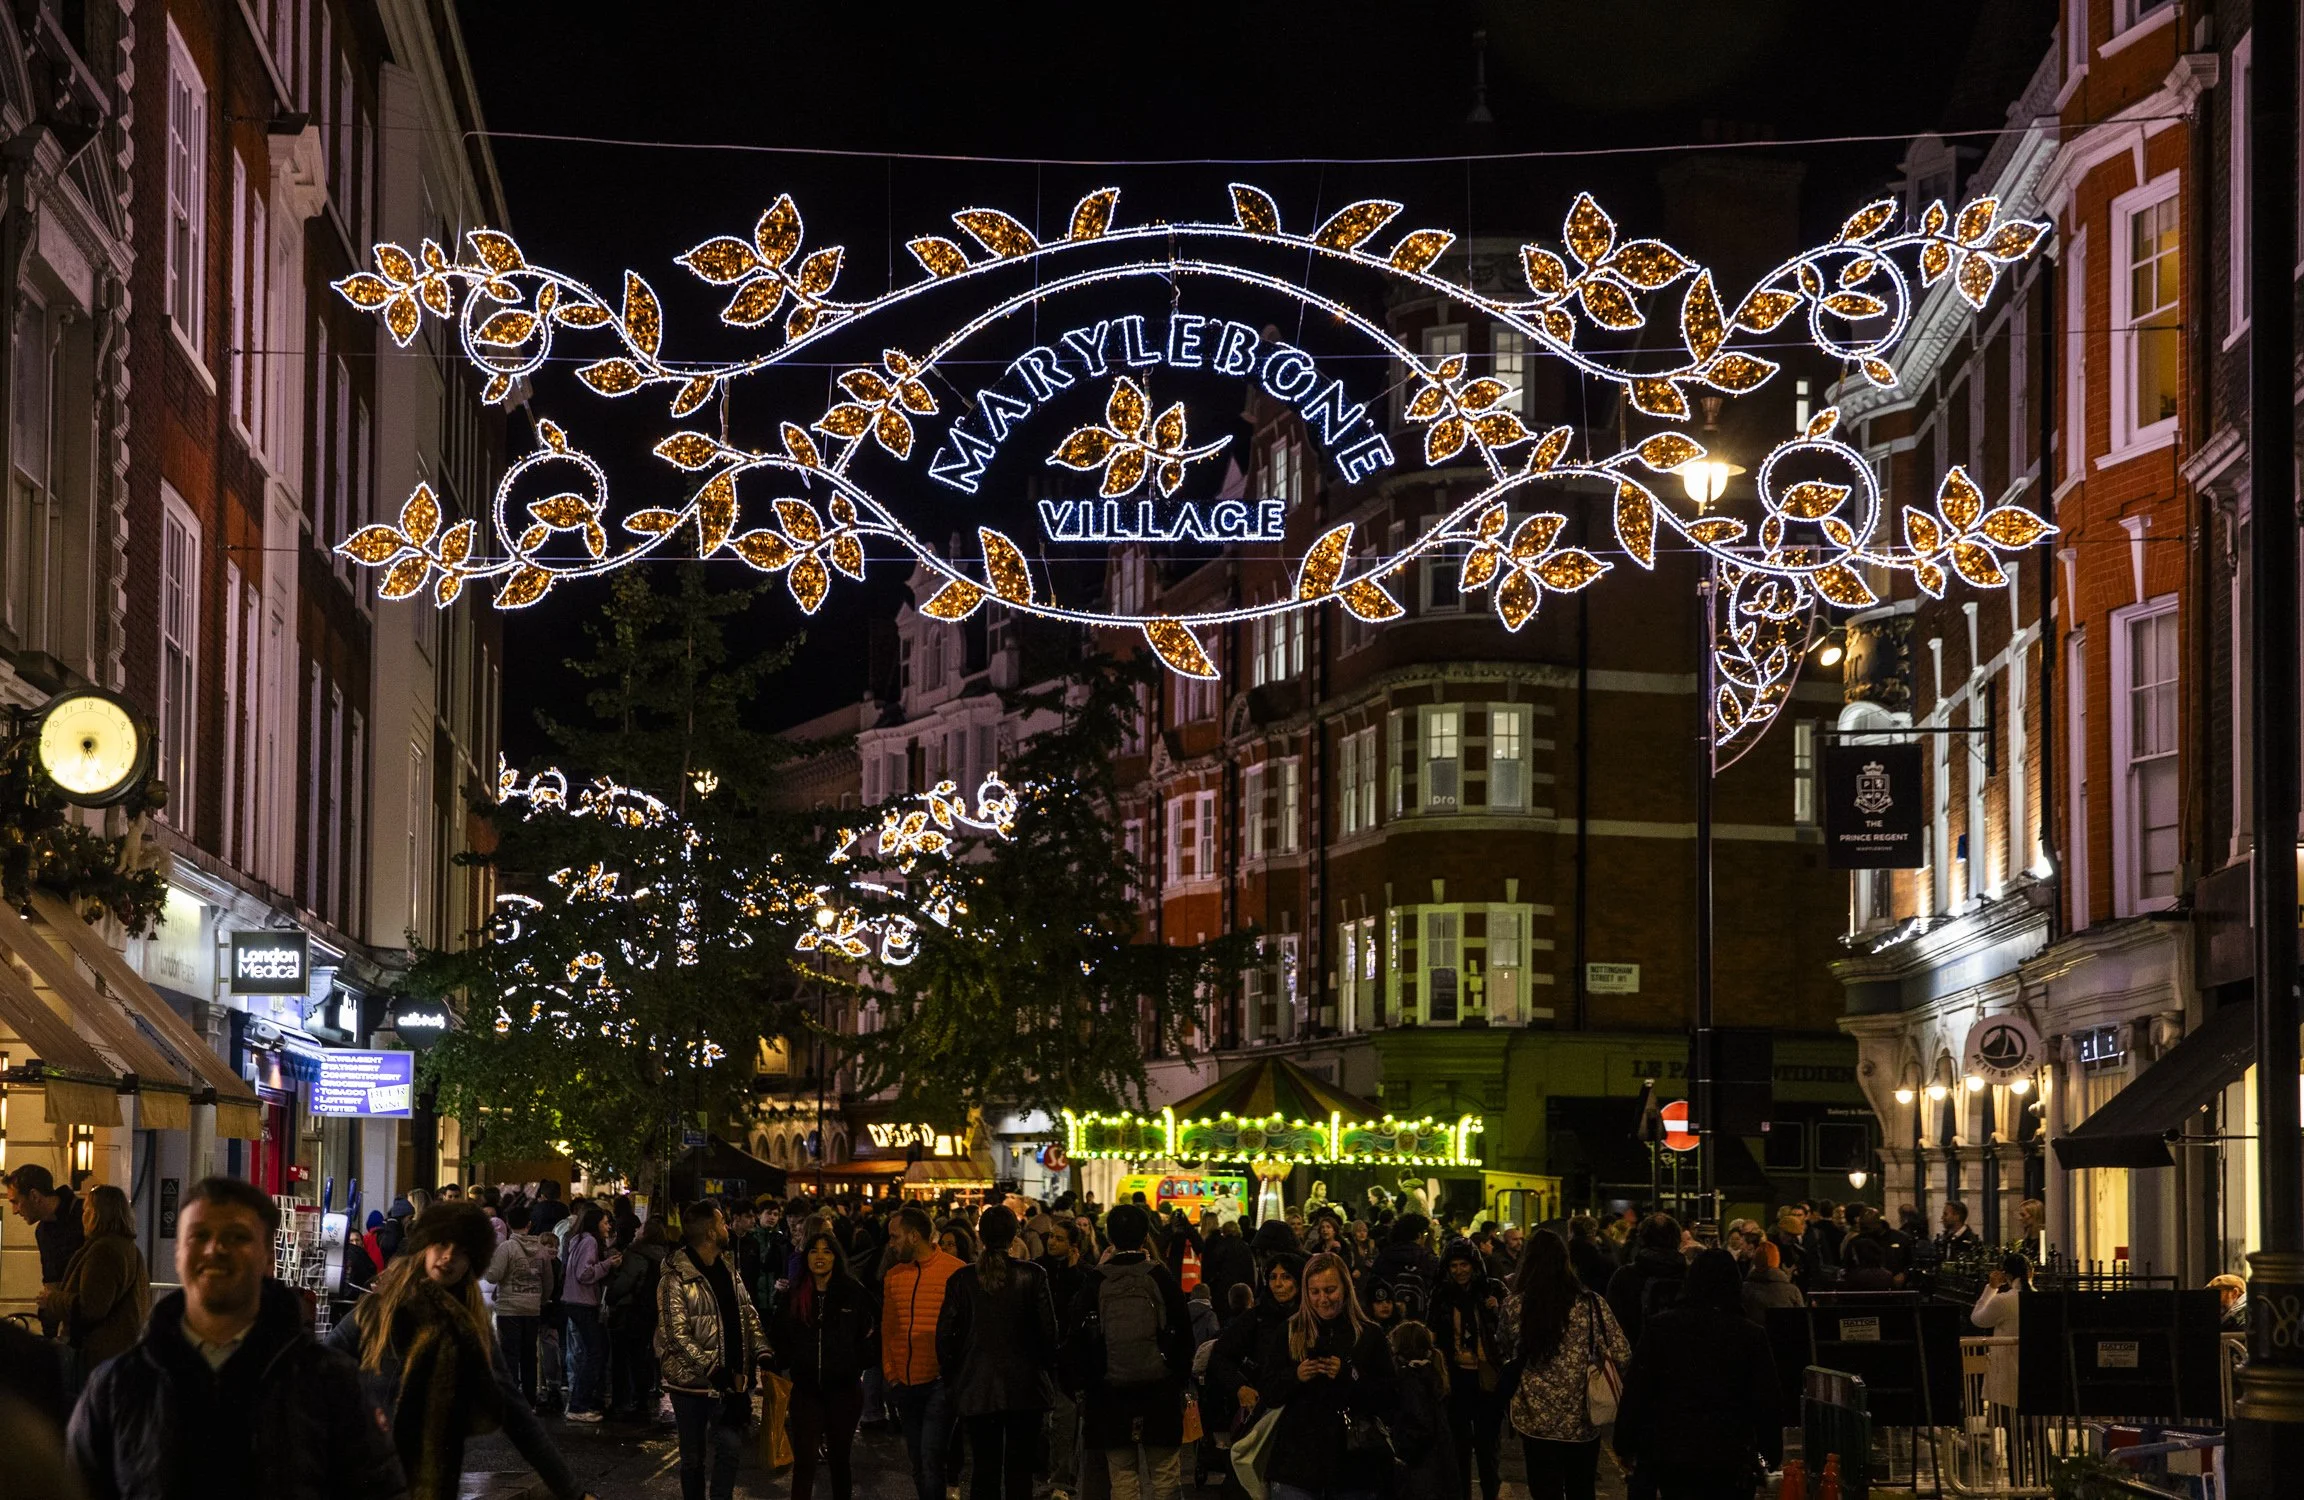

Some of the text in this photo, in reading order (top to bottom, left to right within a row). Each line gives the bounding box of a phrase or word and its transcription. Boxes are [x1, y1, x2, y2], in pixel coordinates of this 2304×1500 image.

[928, 314, 1396, 494] MARYLEBONE
[1038, 499, 1286, 541] VILLAGE
[1865, 820, 1883, 828] THE
[1840, 833, 1909, 842] PRINCE REGENT
[238, 947, 300, 963] London
[238, 961, 300, 979] Medical
[1590, 966, 1633, 974] NOTTINGHAM
[321, 1063, 380, 1072] STATIONERY
[1632, 1059, 1663, 1078] LE
[1972, 1054, 2035, 1078] PETIT BATEAU
[320, 1071, 402, 1081] CONFECTIONERY
[319, 1087, 366, 1096] TOBACCO
[319, 1095, 364, 1104] LOTTERY
[319, 1103, 358, 1112] OYSTER
